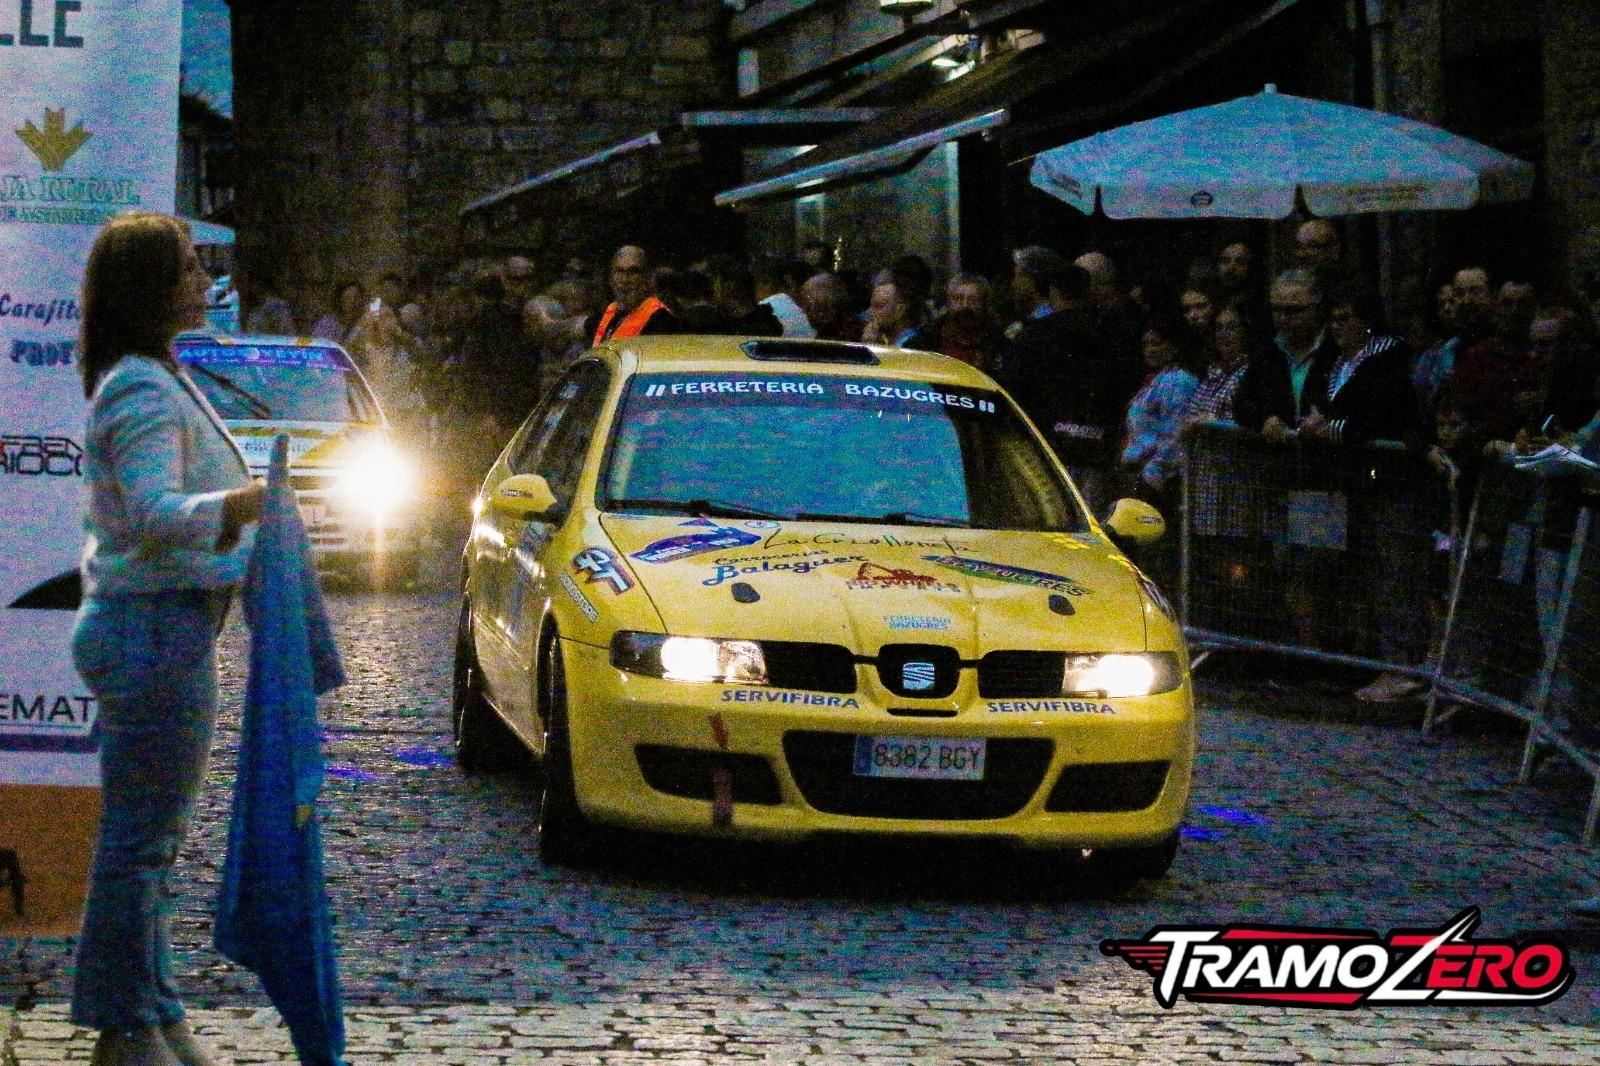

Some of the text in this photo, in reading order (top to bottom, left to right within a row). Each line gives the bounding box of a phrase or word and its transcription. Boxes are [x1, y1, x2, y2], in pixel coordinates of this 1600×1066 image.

[0, 0, 84, 48] LE
[671, 380, 975, 409] FERRETERIA BAZUGRES
[702, 555, 869, 586] Balaguer
[721, 689, 860, 709] SERVIFIBRA
[986, 699, 1116, 715] SERVIFIBRA
[939, 745, 982, 770] BGY
